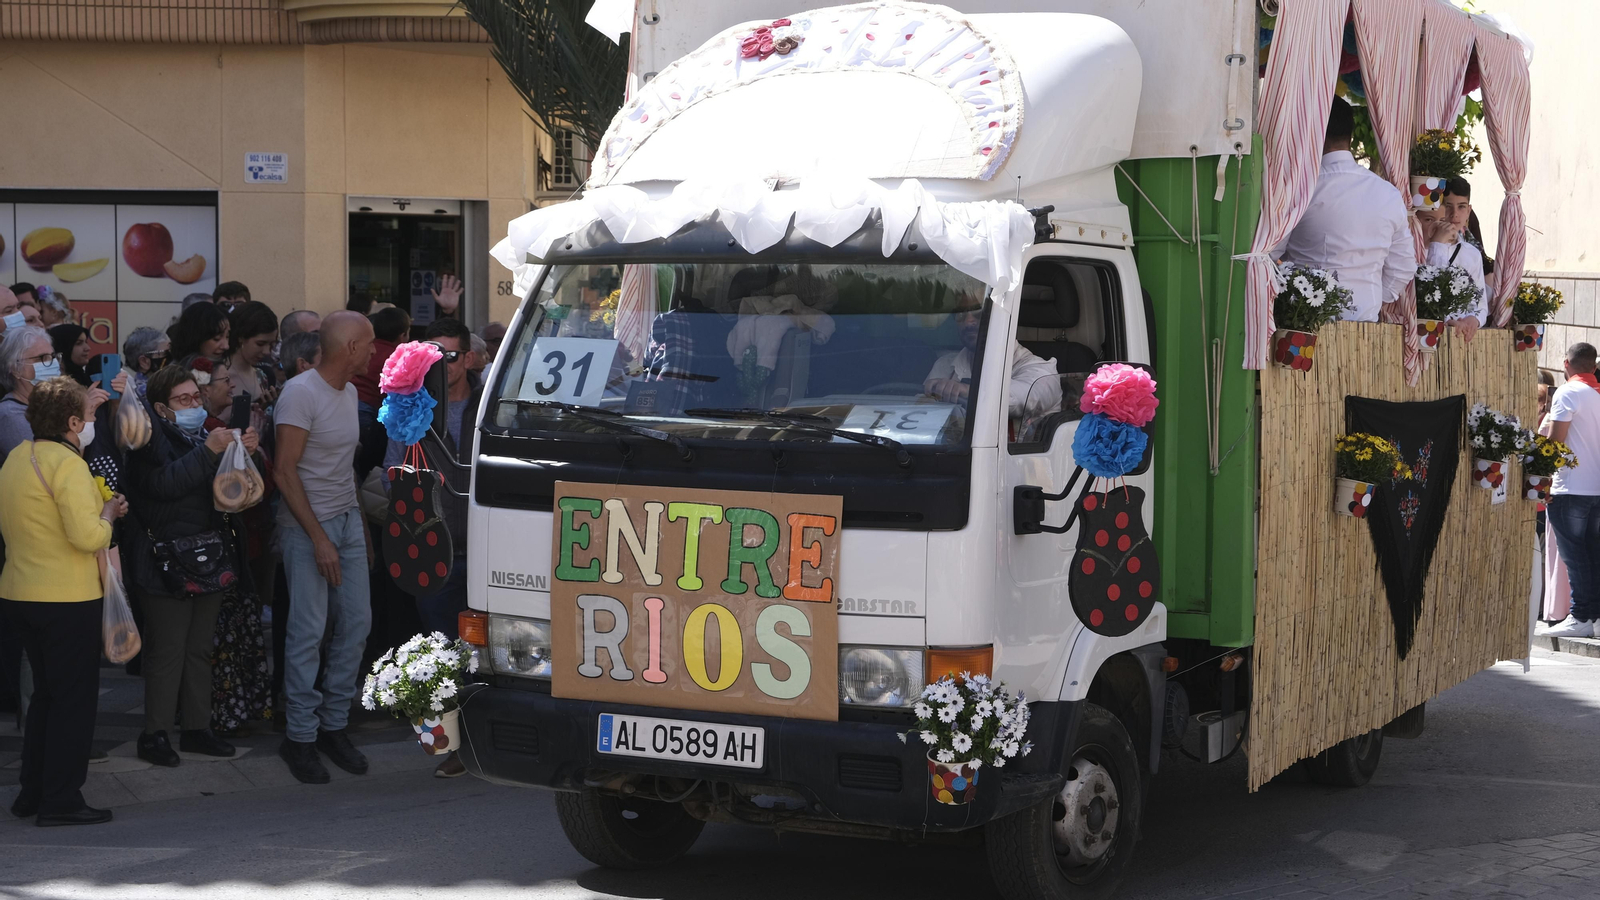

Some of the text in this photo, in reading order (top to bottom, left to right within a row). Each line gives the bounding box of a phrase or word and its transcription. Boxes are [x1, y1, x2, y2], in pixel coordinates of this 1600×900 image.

[497, 281, 513, 296] 58
[535, 350, 594, 397] 31
[555, 496, 837, 604] ENTRE
[491, 570, 546, 589] NISSAN
[576, 593, 812, 700] RIOS
[602, 720, 757, 763] E AL 0589 AH
